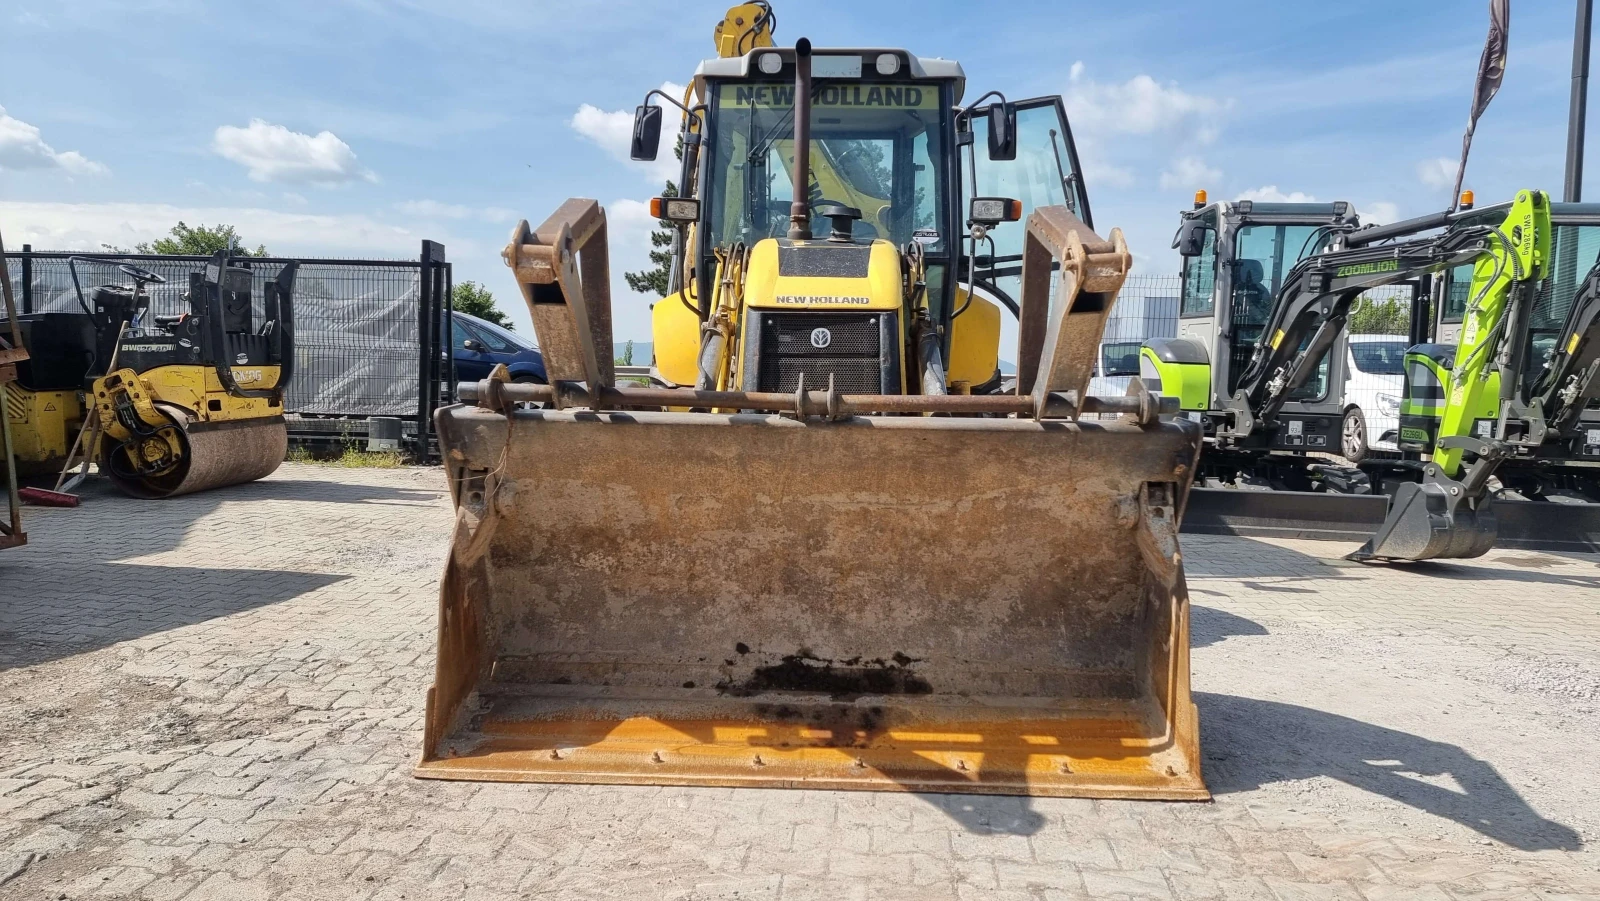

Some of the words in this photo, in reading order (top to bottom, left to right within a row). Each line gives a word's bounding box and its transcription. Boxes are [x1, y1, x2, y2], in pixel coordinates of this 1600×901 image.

[736, 86, 795, 105] NEW
[1523, 214, 1531, 232] SWL
[1337, 259, 1398, 277] ZOOMLION
[776, 296, 806, 304] NEW
[809, 296, 870, 304] HOLLAND
[231, 369, 263, 382] OMAG
